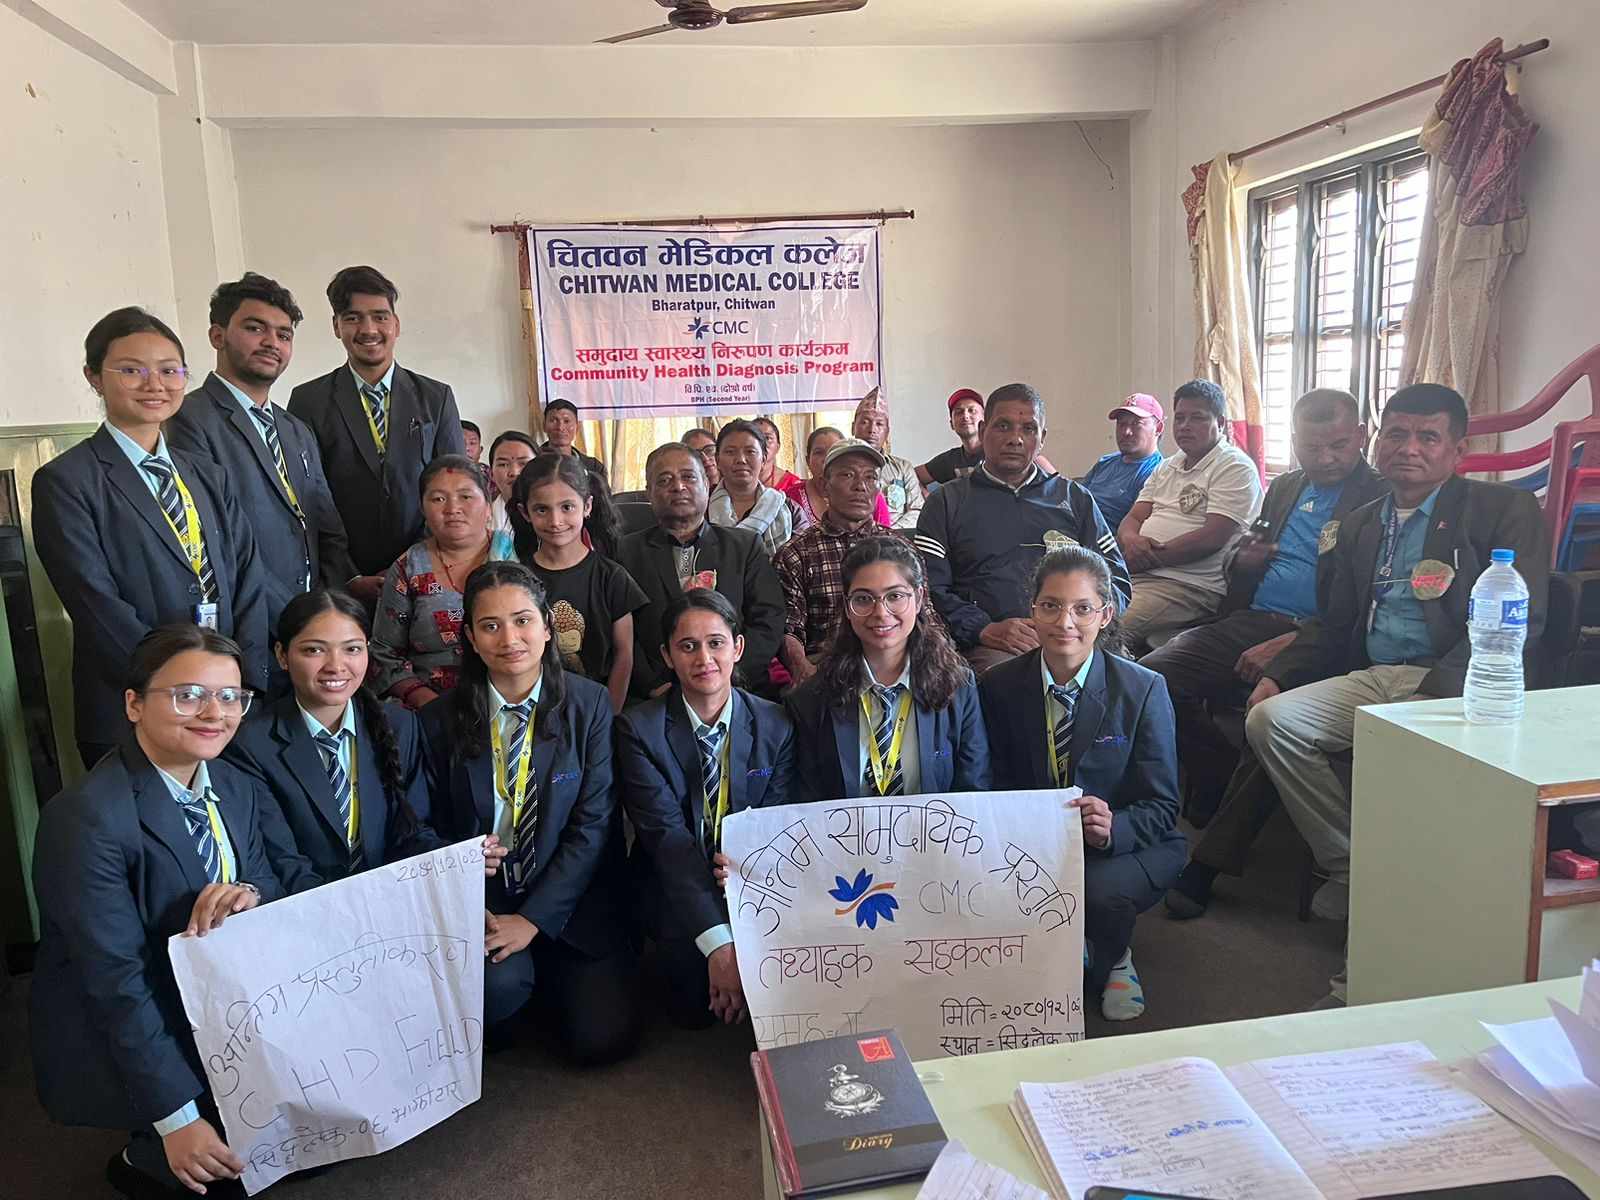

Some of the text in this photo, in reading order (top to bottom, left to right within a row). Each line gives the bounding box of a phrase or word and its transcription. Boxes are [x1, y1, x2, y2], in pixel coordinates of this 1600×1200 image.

[546, 238, 649, 269] चितवन
[658, 237, 775, 267] मेडिकल
[558, 271, 860, 295] CHITWAN MEDICAL COLLEGE
[652, 297, 776, 313] Bharatpur, Chitwan
[712, 320, 749, 335] CMC
[575, 345, 638, 366] समुदाय
[645, 345, 706, 361] स्वास्थ्य
[779, 339, 849, 358] कार्यक्रम
[550, 359, 875, 382] Community Health Diagnosis Program
[824, 799, 984, 865] सामुदायिक
[849, 1133, 893, 1150] Diary
